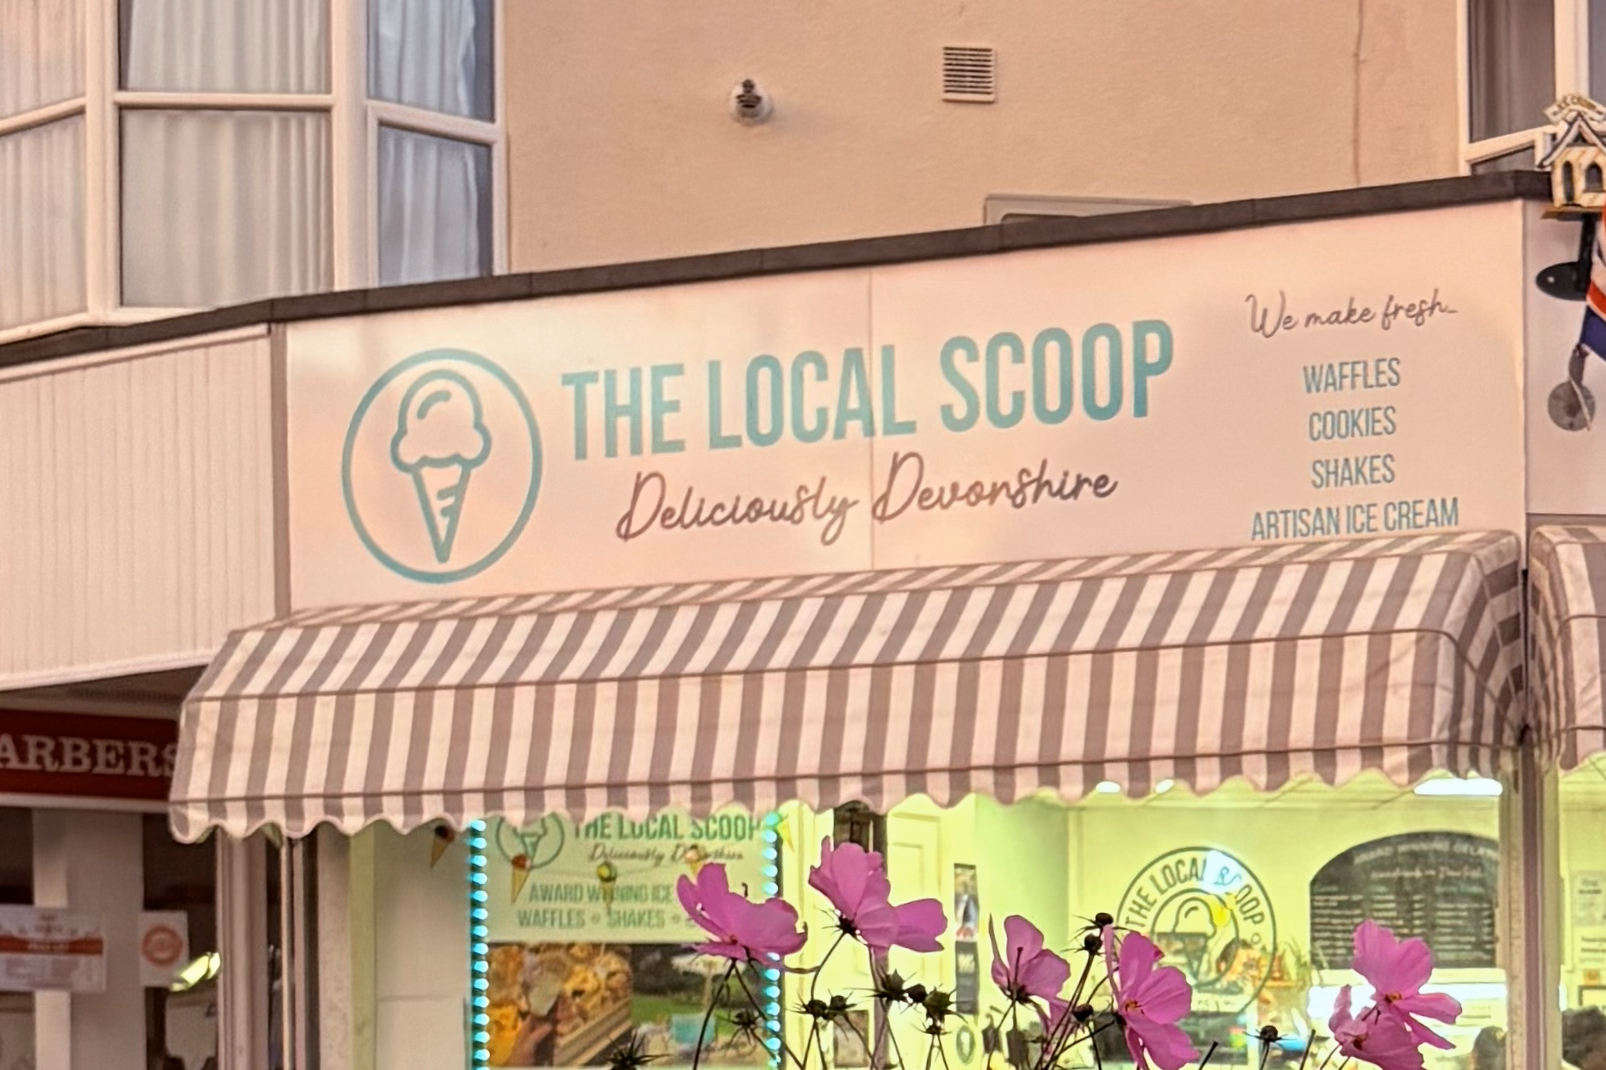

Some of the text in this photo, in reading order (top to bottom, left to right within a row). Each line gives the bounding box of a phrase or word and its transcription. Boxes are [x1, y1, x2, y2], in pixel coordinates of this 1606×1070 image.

[1246, 290, 1298, 338] We
[1305, 297, 1376, 329] make
[560, 319, 1174, 461] THE LOCAL SCOOP
[1303, 357, 1401, 394] WAFFLES
[1308, 405, 1396, 442] COOKIES
[1311, 453, 1395, 489] SHAKES
[615, 452, 1118, 546] Deliciously Devonshire
[1251, 497, 1459, 541] ARTISAN ICE CREAM
[618, 812, 685, 839] LOCAL
[529, 884, 583, 902] AWARD
[587, 885, 649, 903] WNING
[1125, 886, 1157, 928] THE
[1212, 865, 1266, 926] OOP
[518, 909, 584, 928] WAFFLES
[608, 909, 666, 928] SHAKES
